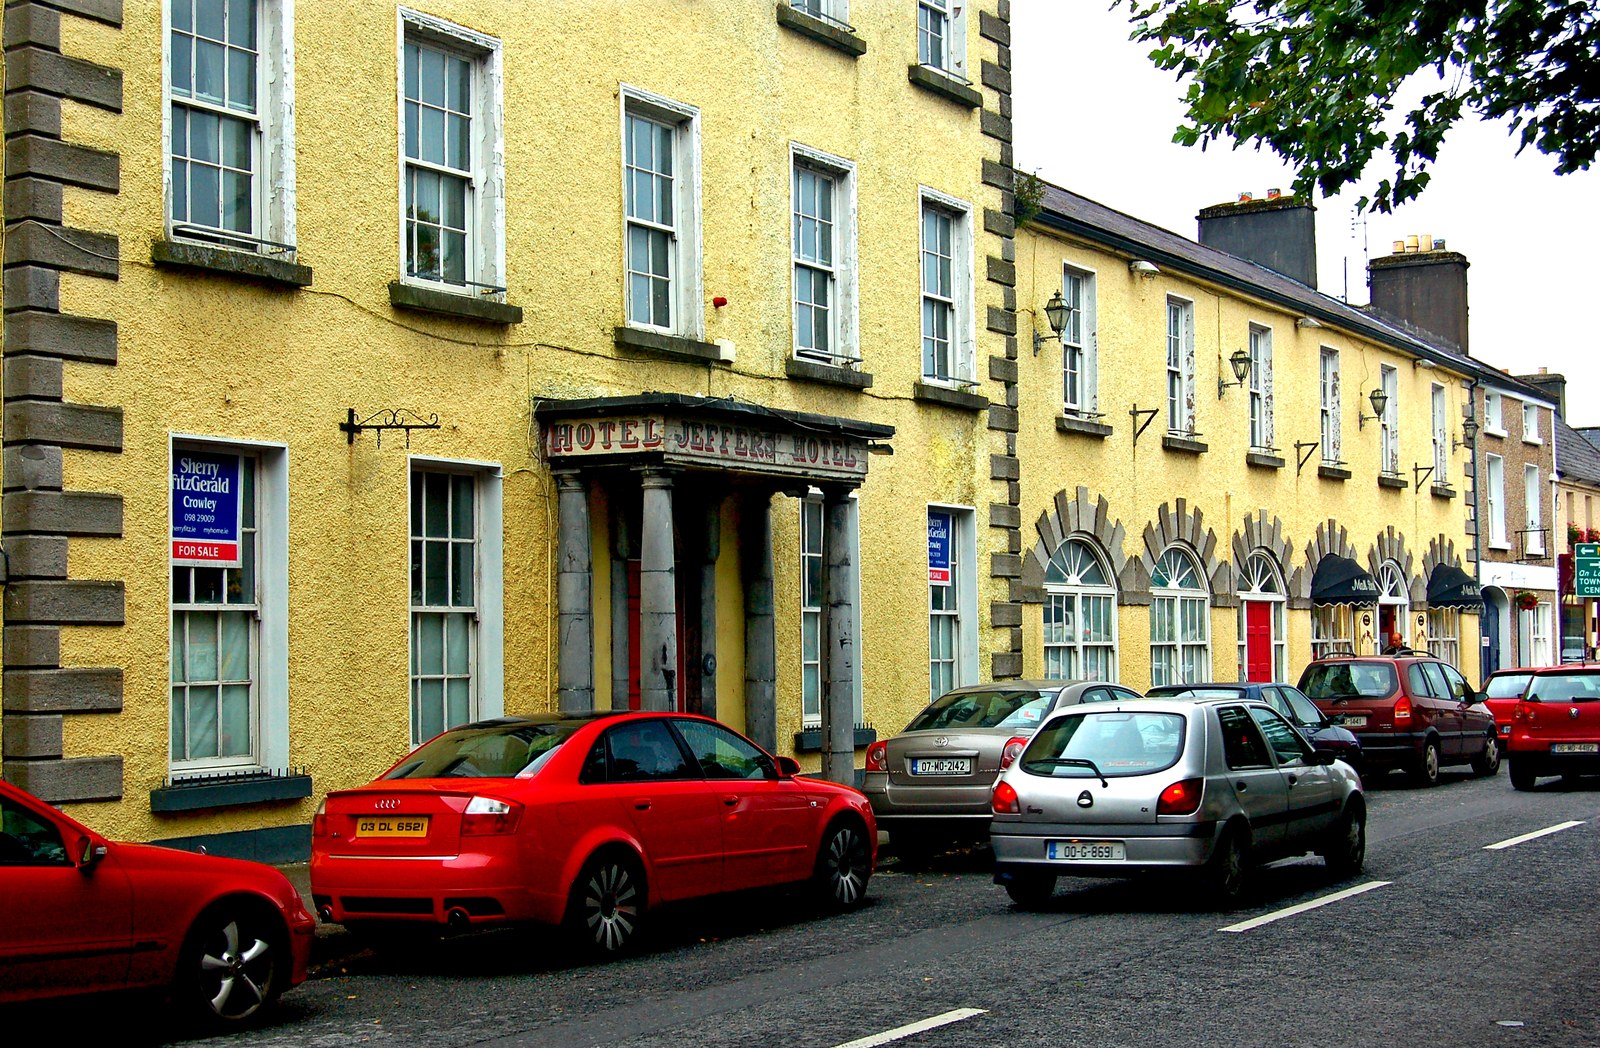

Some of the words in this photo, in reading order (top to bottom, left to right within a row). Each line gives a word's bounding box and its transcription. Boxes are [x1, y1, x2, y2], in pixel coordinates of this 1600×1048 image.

[551, 418, 662, 452] HOTEL
[791, 432, 857, 467] HOTEL
[180, 457, 219, 480] Sherry
[183, 495, 217, 512] Crowley
[184, 513, 196, 522] 098
[196, 514, 215, 523] 29009
[178, 545, 196, 556] FOR
[197, 546, 219, 557] SALE
[360, 822, 375, 831] 03
[378, 822, 393, 831] DL
[397, 822, 424, 831] 6521
[1064, 846, 1113, 858] 00-G-8691
